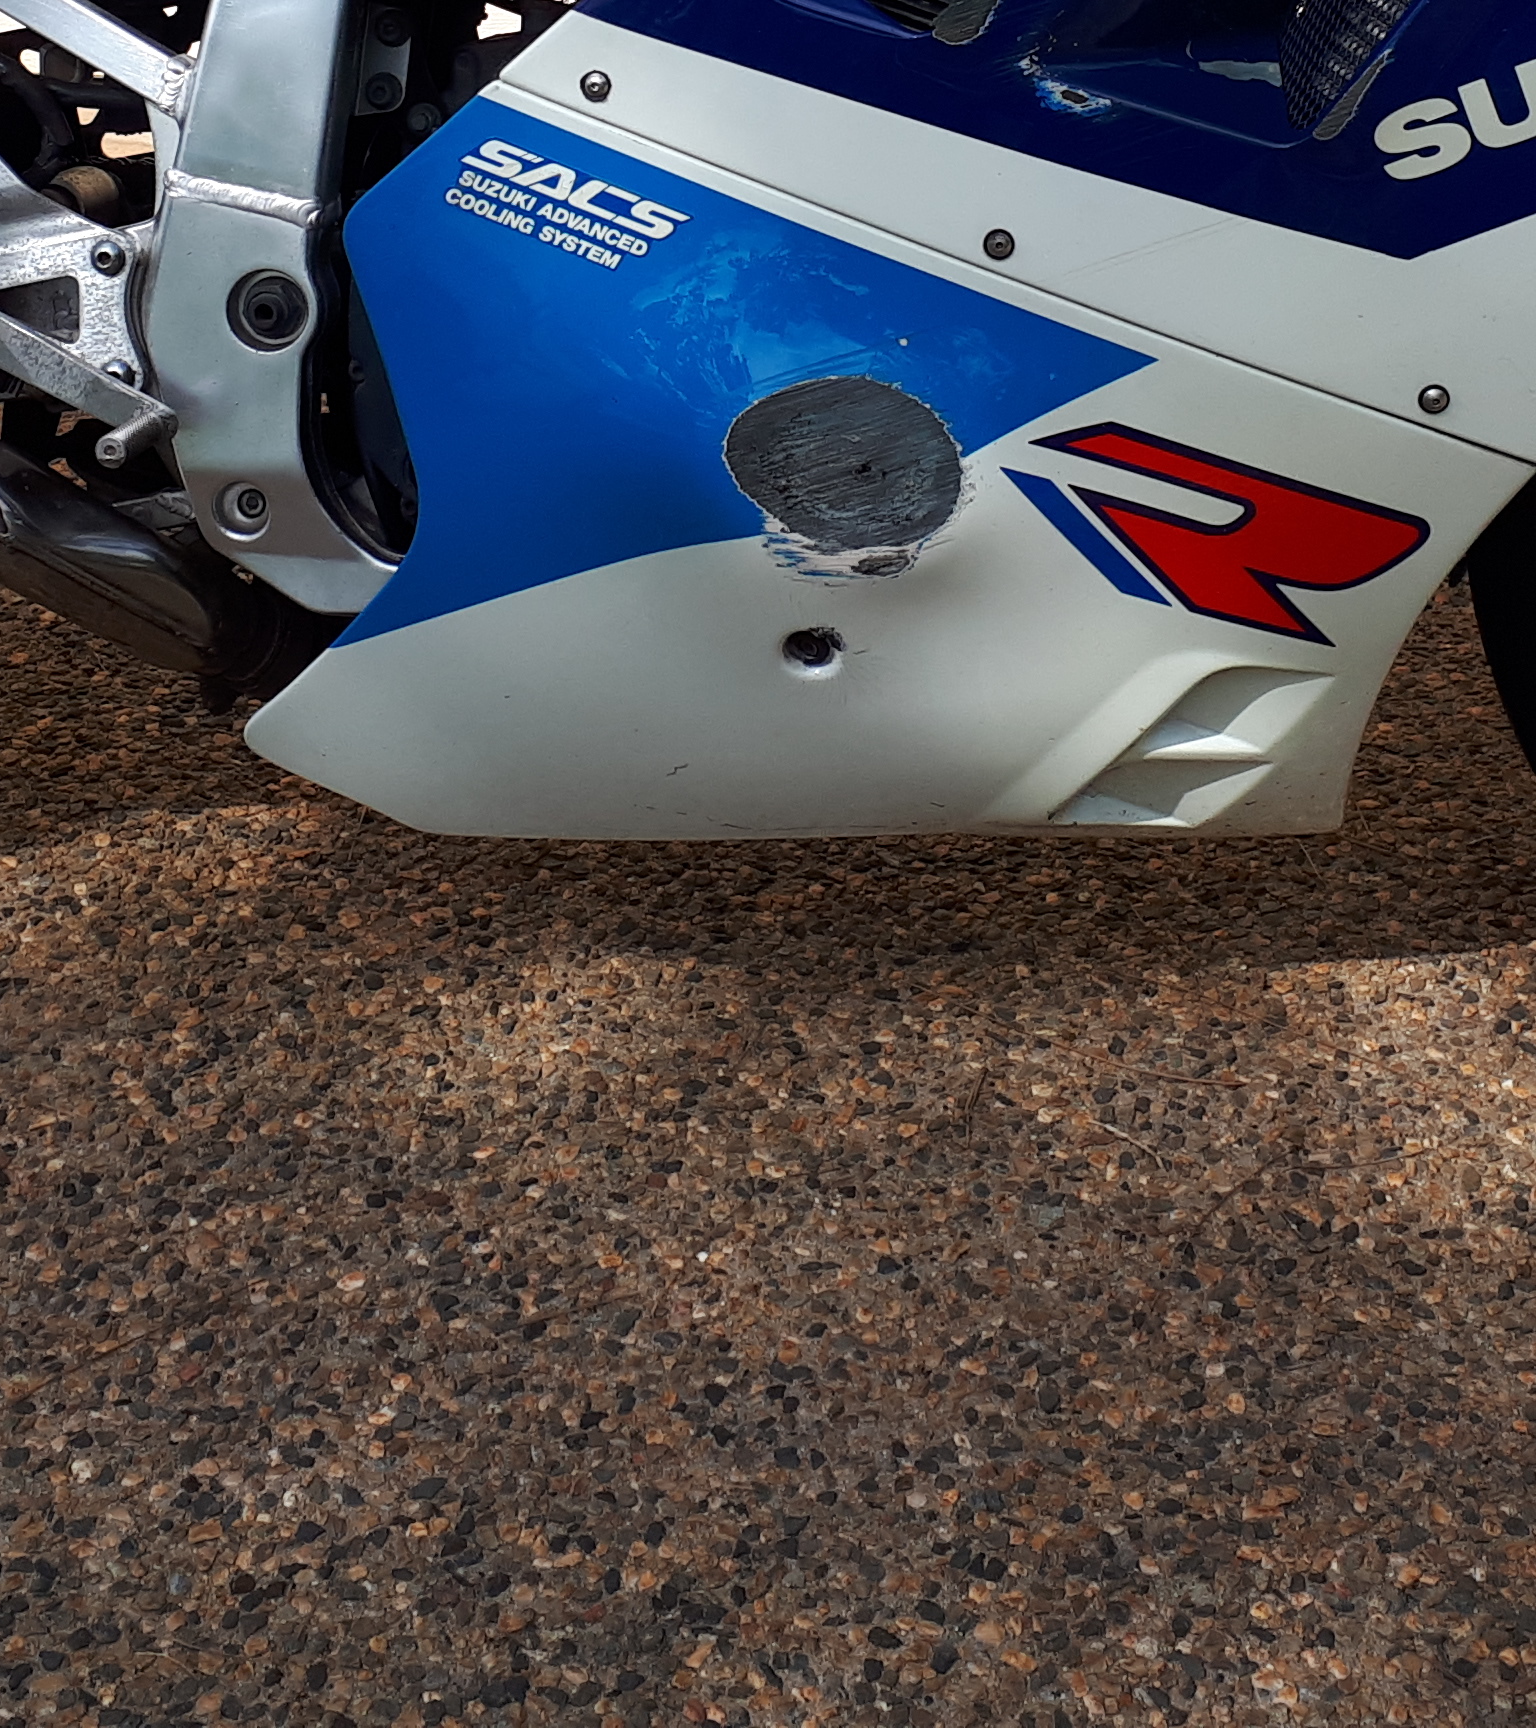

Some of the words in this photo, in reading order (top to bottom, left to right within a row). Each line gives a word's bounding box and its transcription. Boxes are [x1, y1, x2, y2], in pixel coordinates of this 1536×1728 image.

[445, 188, 535, 236] COOLING
[539, 225, 622, 270] SYSTEM
[458, 170, 537, 211] SUZUKI
[537, 202, 648, 258] ADVANCED
[460, 139, 691, 241] SACS
[1028, 421, 1431, 648] R
